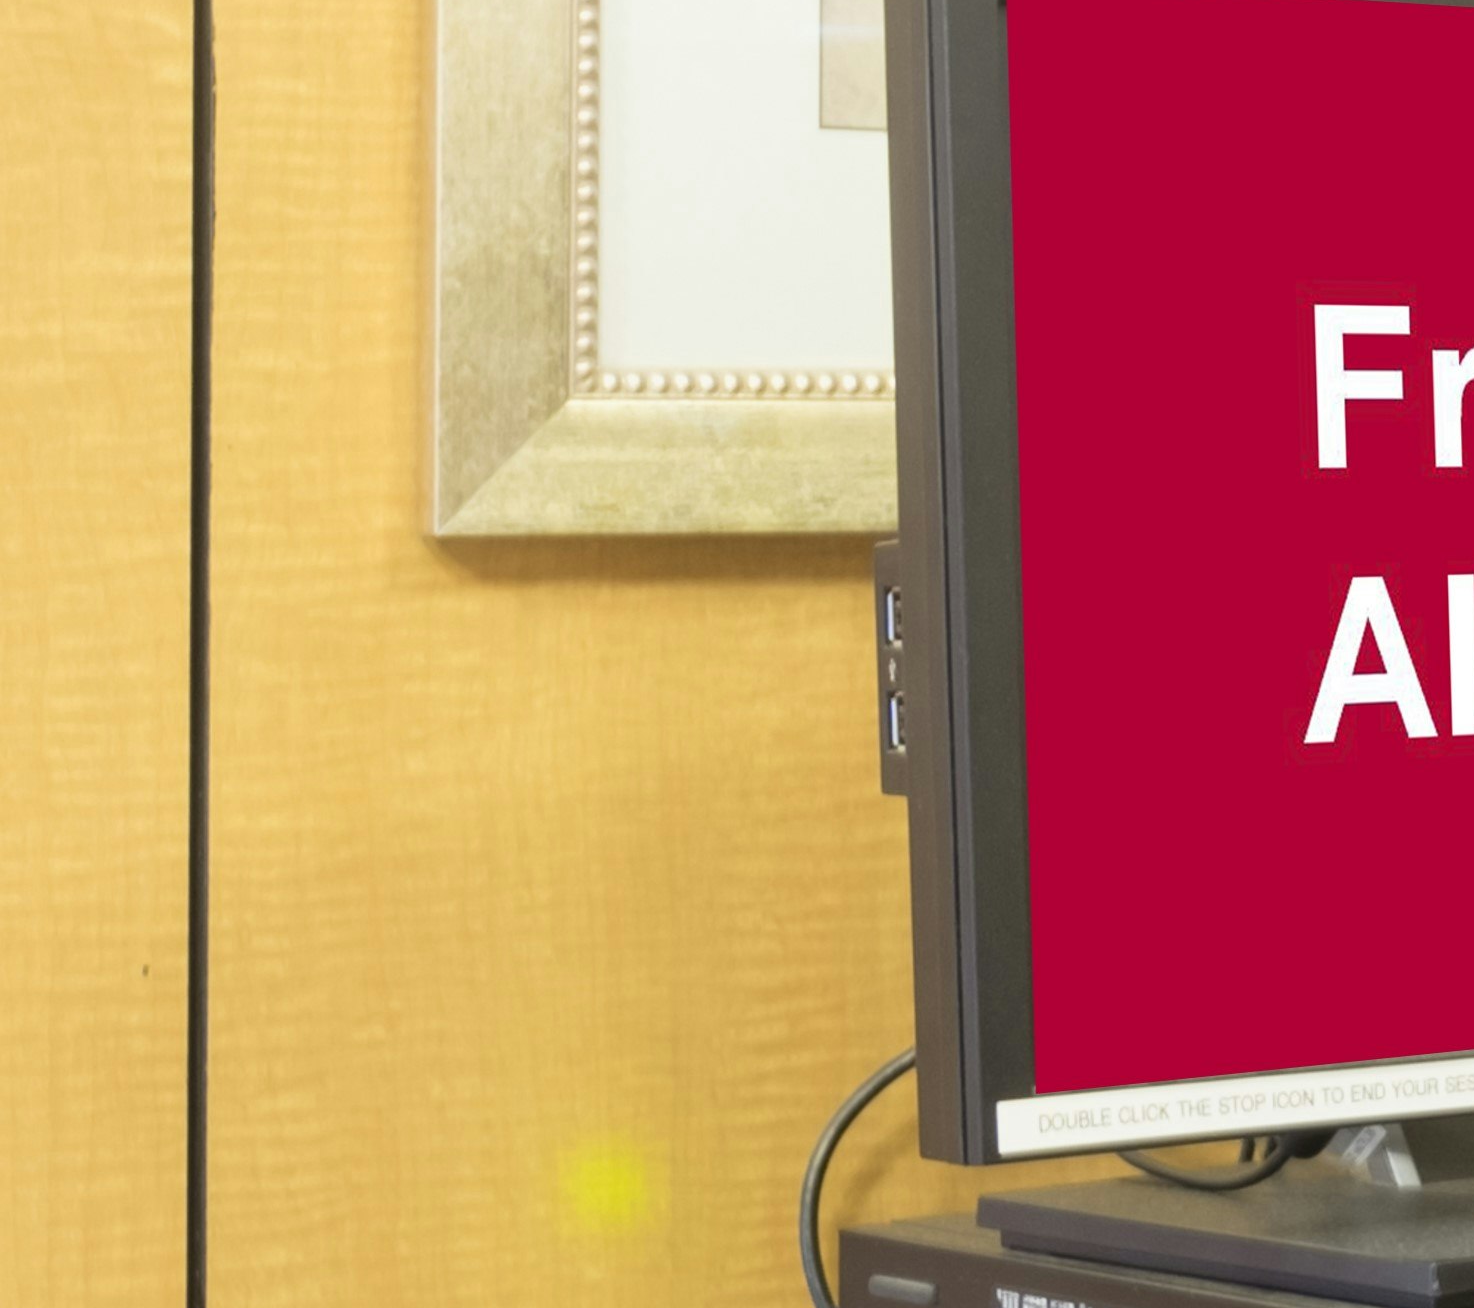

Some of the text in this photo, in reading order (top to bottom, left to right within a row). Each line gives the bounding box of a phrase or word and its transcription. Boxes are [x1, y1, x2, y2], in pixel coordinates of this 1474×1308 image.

[1038, 1107, 1112, 1134] DOUBLE
[1118, 1101, 1171, 1125] CLICK
[1177, 1098, 1212, 1118] THE
[1218, 1093, 1266, 1116] STOP
[1272, 1089, 1315, 1110] ICON
[1322, 1086, 1345, 1105] TO
[1351, 1082, 1386, 1102] END
[1392, 1077, 1439, 1098] YOUR
